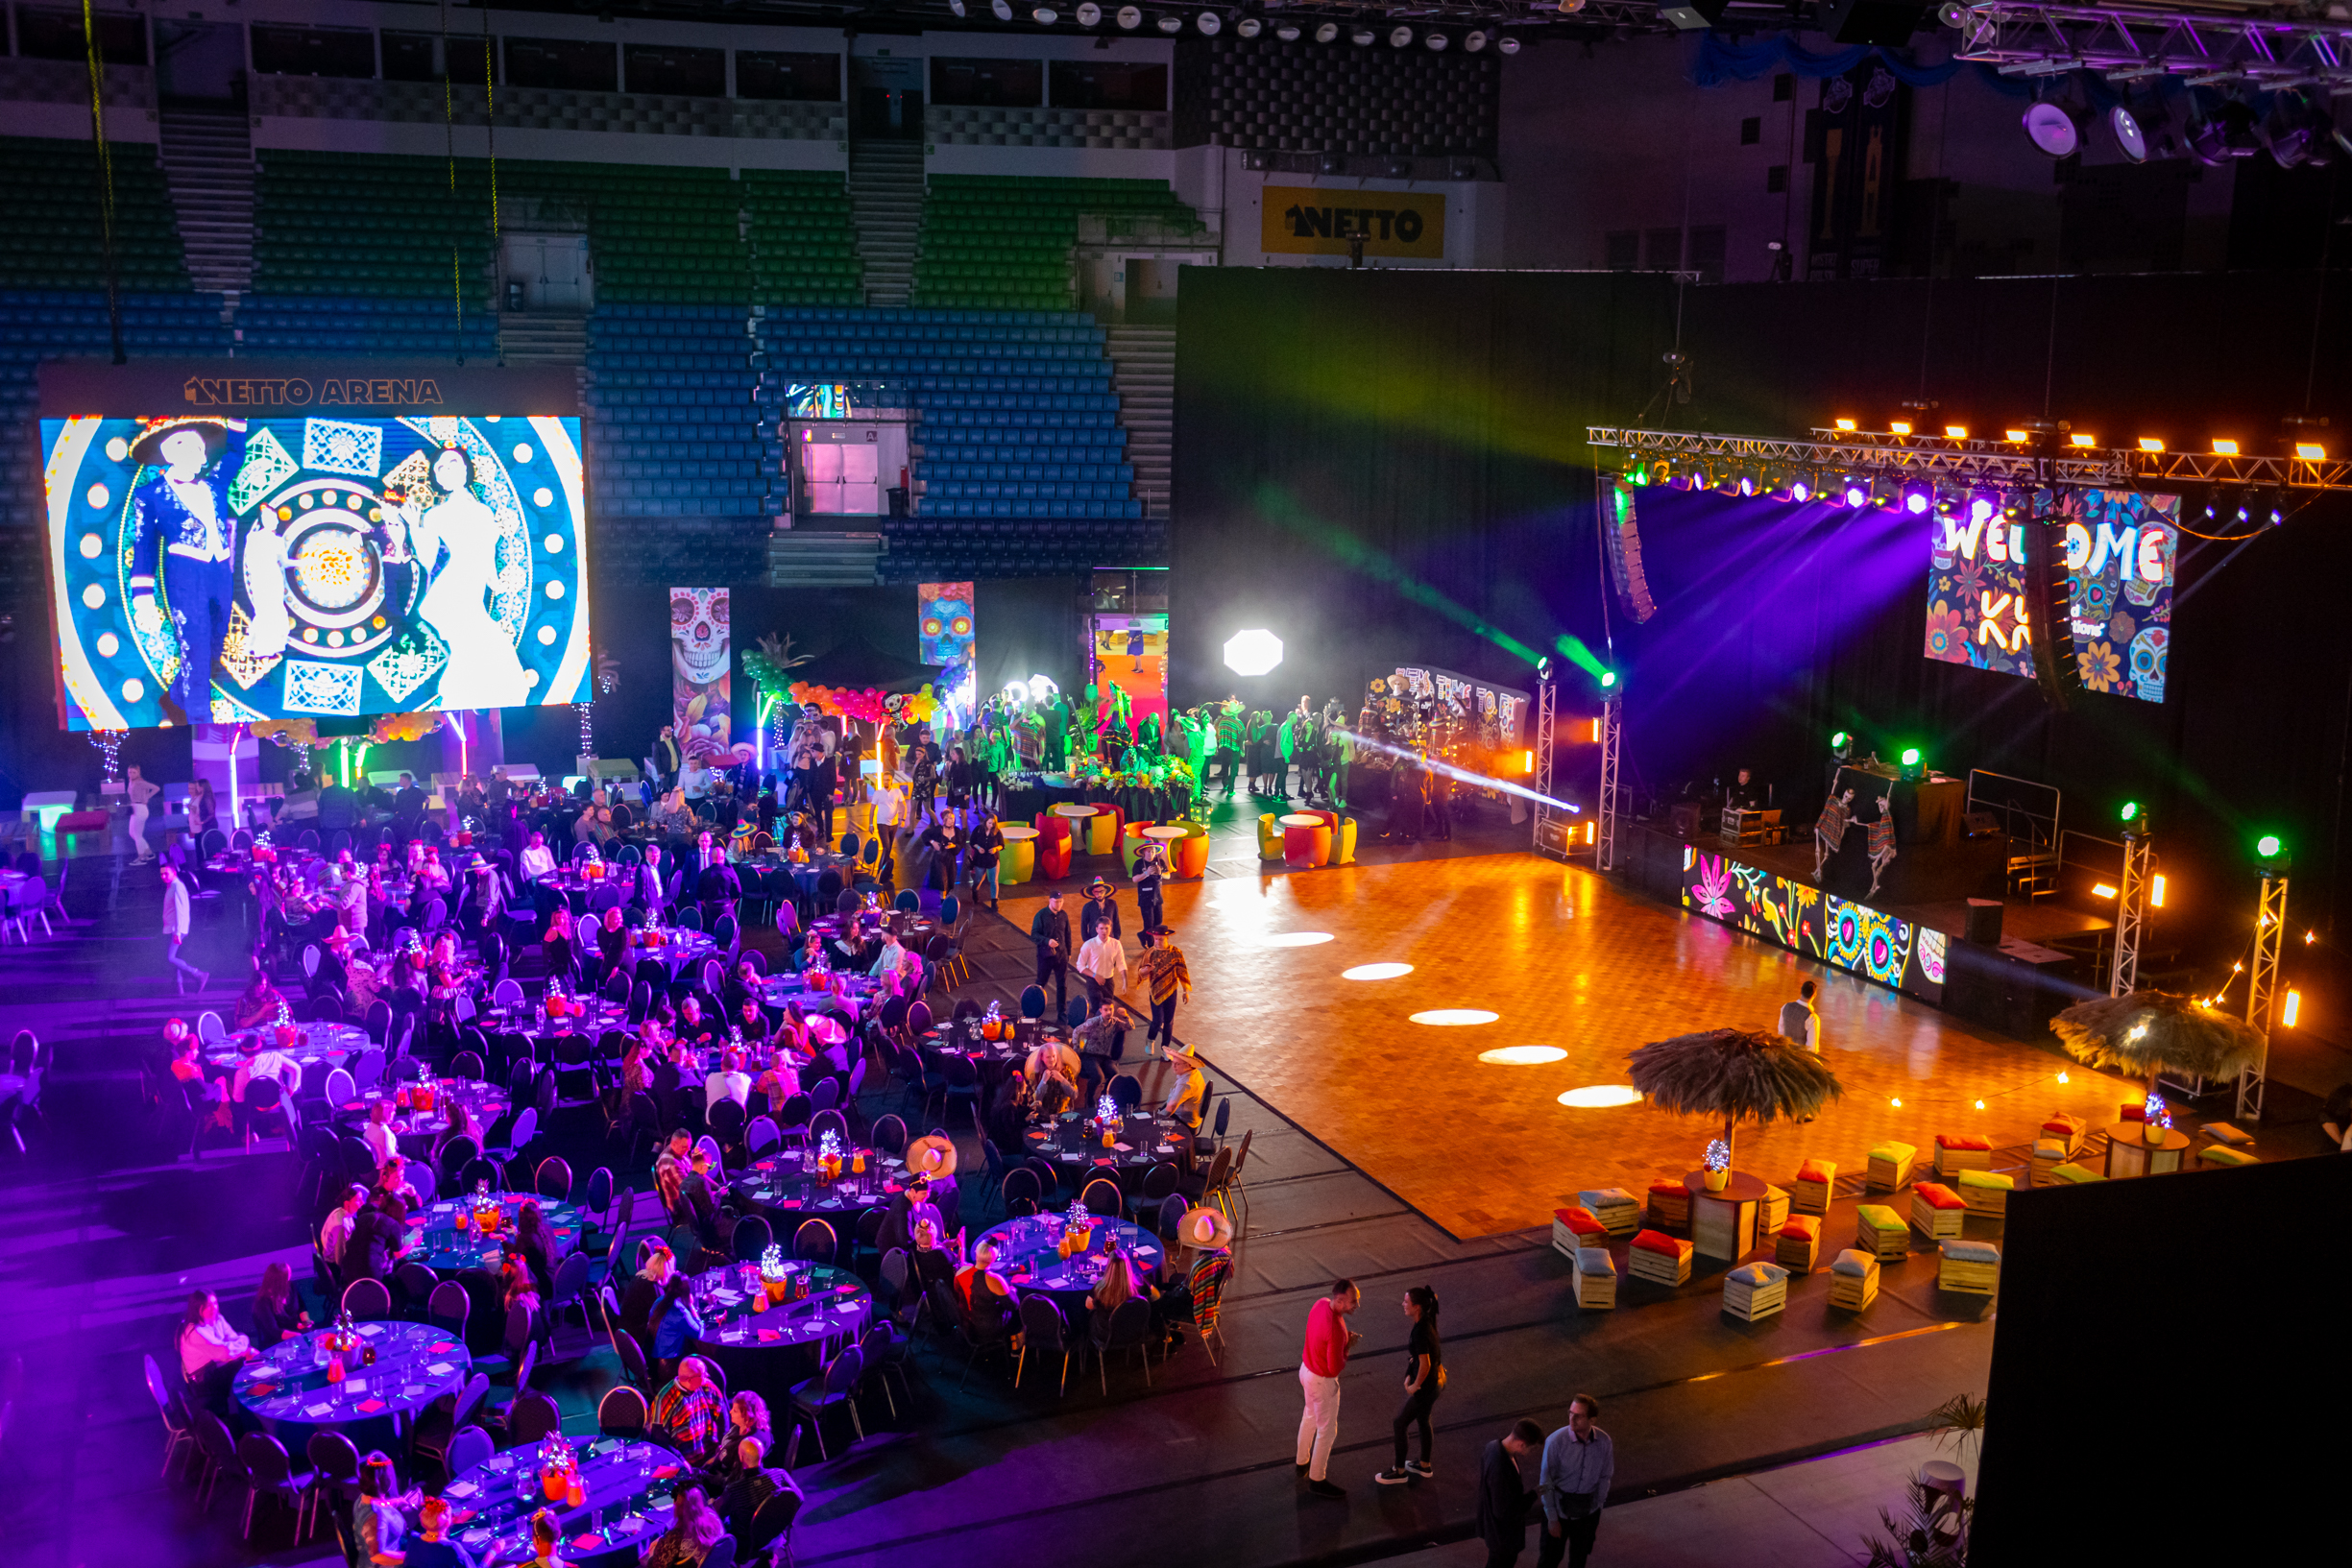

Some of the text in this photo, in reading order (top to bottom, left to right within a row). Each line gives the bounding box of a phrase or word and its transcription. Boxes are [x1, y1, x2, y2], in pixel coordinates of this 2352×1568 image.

[1304, 205, 1423, 243] NETTO
[201, 378, 443, 405] NETTO ARENA
[1943, 514, 2165, 582] WELOME
[2071, 619, 2106, 638] tions
[1476, 687, 1495, 715] TO
